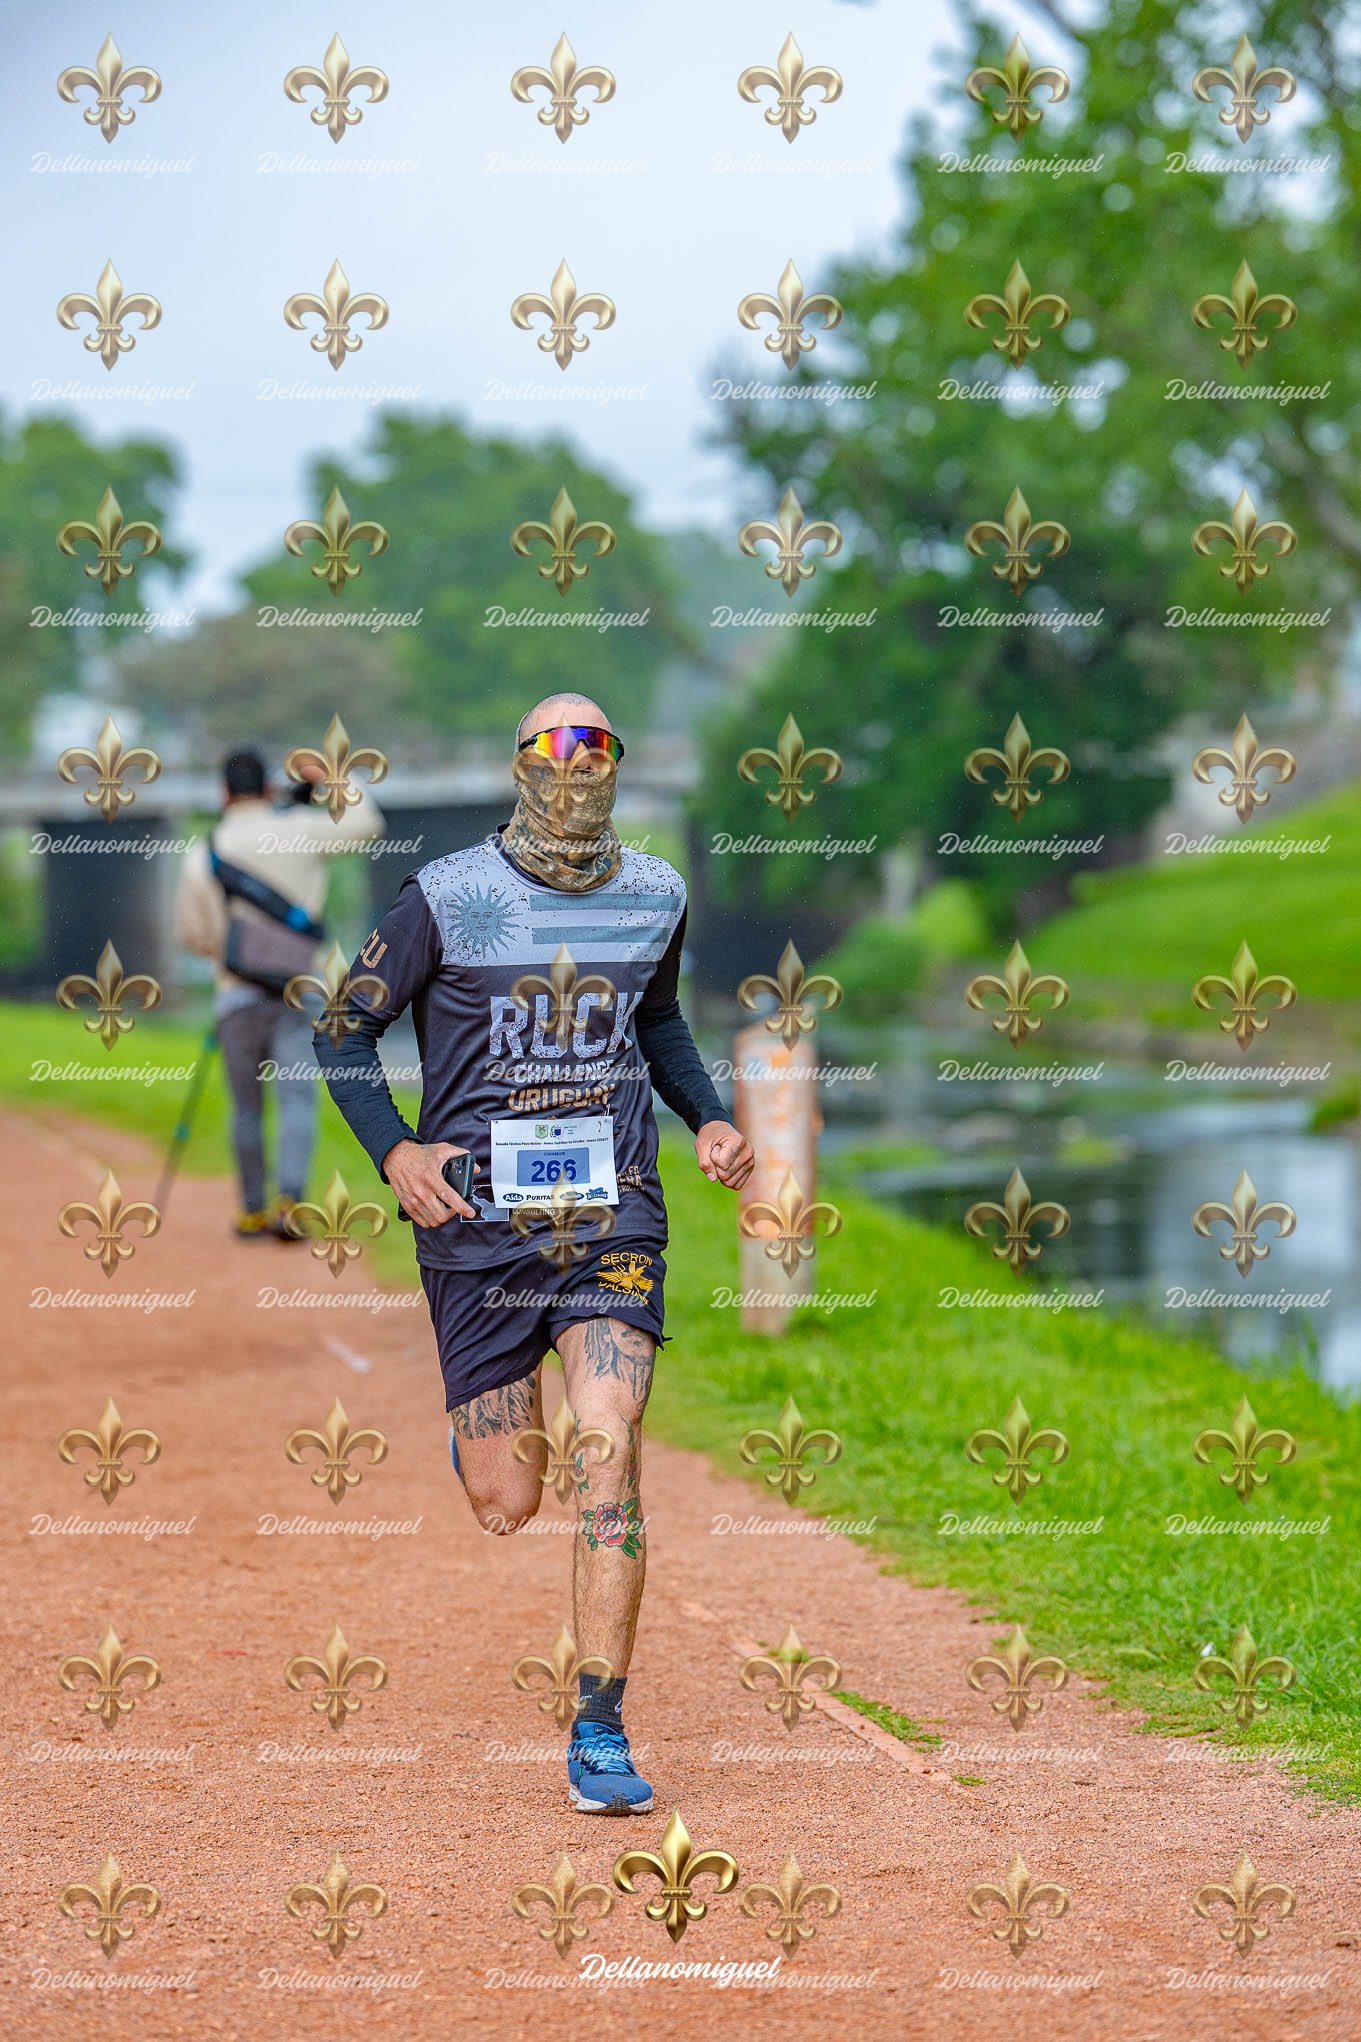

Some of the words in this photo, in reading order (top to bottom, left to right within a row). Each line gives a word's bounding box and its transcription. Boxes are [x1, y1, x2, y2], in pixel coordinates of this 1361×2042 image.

[490, 992, 644, 1059] RUCK
[514, 1060, 614, 1084] CHALLENGE
[508, 1084, 616, 1112] URUGUAY
[531, 1159, 577, 1183] 266
[504, 1194, 523, 1202] Aida
[526, 1194, 555, 1202] PURITAS
[600, 1252, 653, 1266] SECRON
